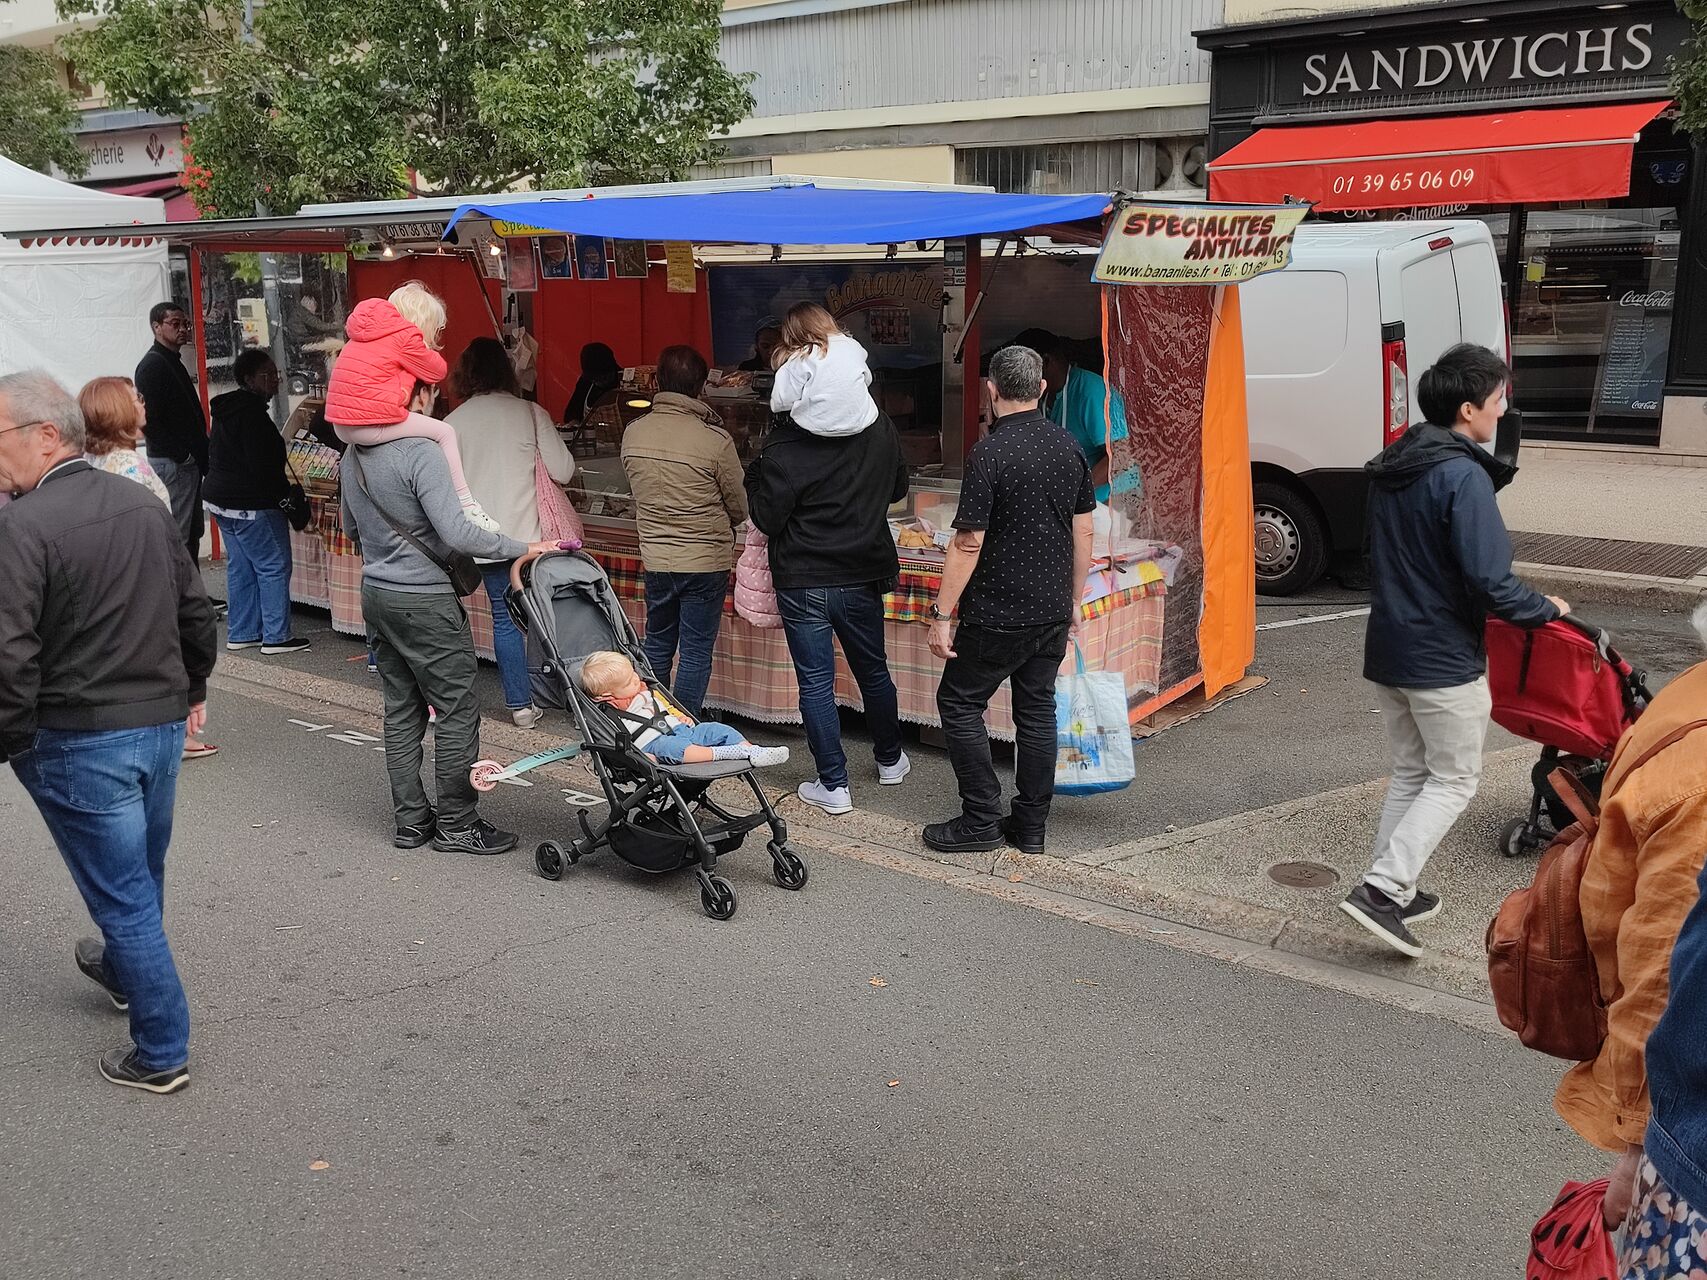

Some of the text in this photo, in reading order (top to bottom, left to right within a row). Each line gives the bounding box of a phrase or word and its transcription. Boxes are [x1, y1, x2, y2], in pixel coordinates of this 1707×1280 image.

[1303, 23, 1652, 97] SANDWICHS
[87, 141, 124, 165] cherie
[1333, 168, 1474, 194] 01 39 65 06 09
[1122, 212, 1276, 238] SPECIALITES
[1241, 262, 1253, 276] 01
[1273, 249, 1284, 264] 13
